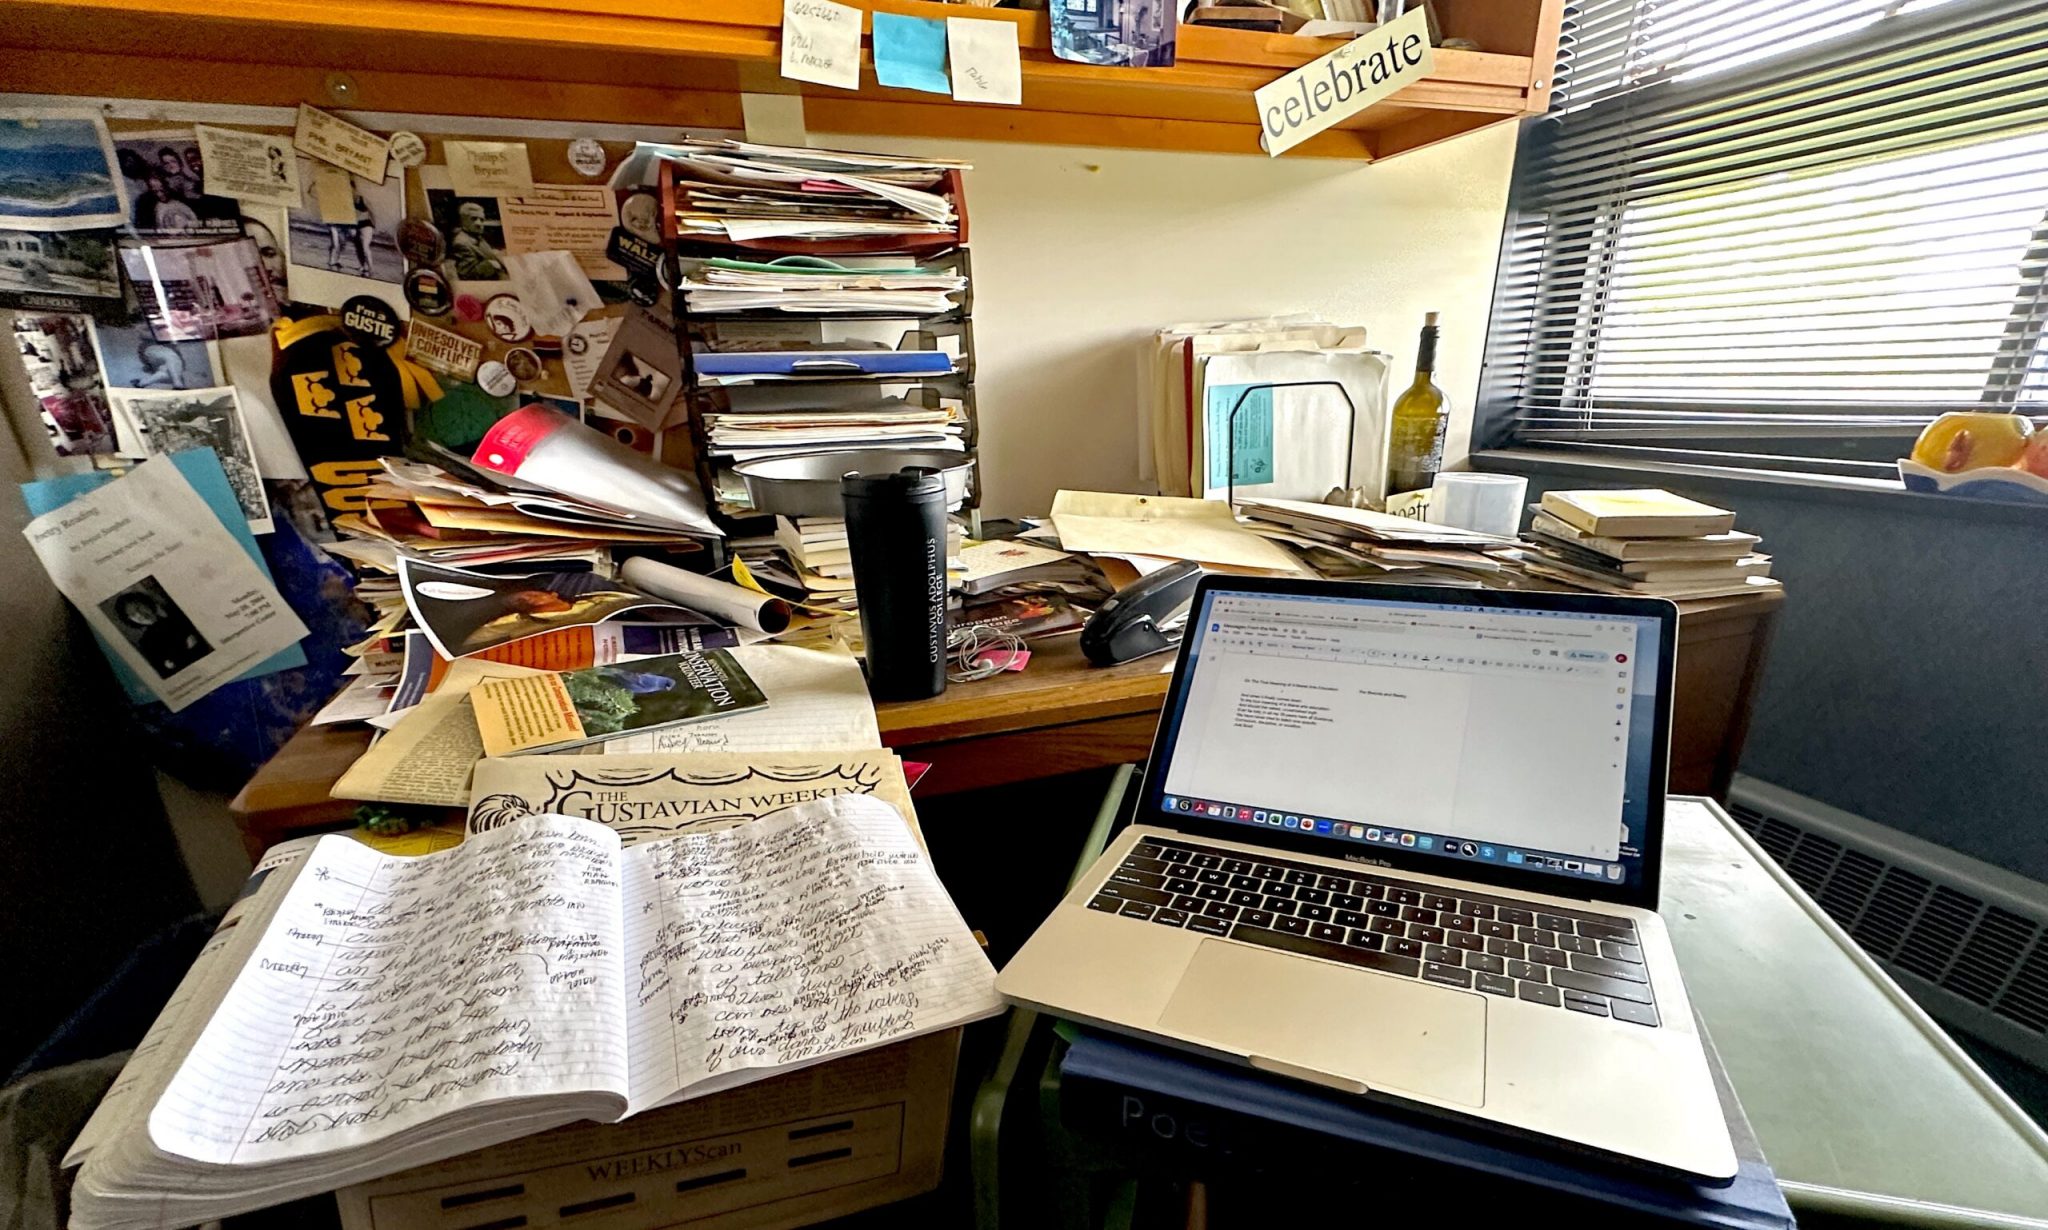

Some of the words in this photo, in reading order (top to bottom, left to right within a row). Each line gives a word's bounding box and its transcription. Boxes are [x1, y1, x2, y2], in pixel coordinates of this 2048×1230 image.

[1265, 31, 1424, 138] celebrate
[344, 312, 395, 341] GUSTIE
[416, 338, 472, 369] CONFLICT
[927, 537, 937, 602] ADOLPHUS
[936, 573, 944, 625] COLLEGE
[930, 606, 938, 663] GUSTAVUS
[951, 615, 1008, 629] uropean
[677, 661, 704, 690] VOLUNTEER
[558, 789, 742, 823] GUSTAVIAN
[597, 791, 628, 803] THE
[1345, 854, 1377, 866] MacBook
[1379, 860, 1392, 868] Pro
[586, 1142, 741, 1182] WEEKLYScan
